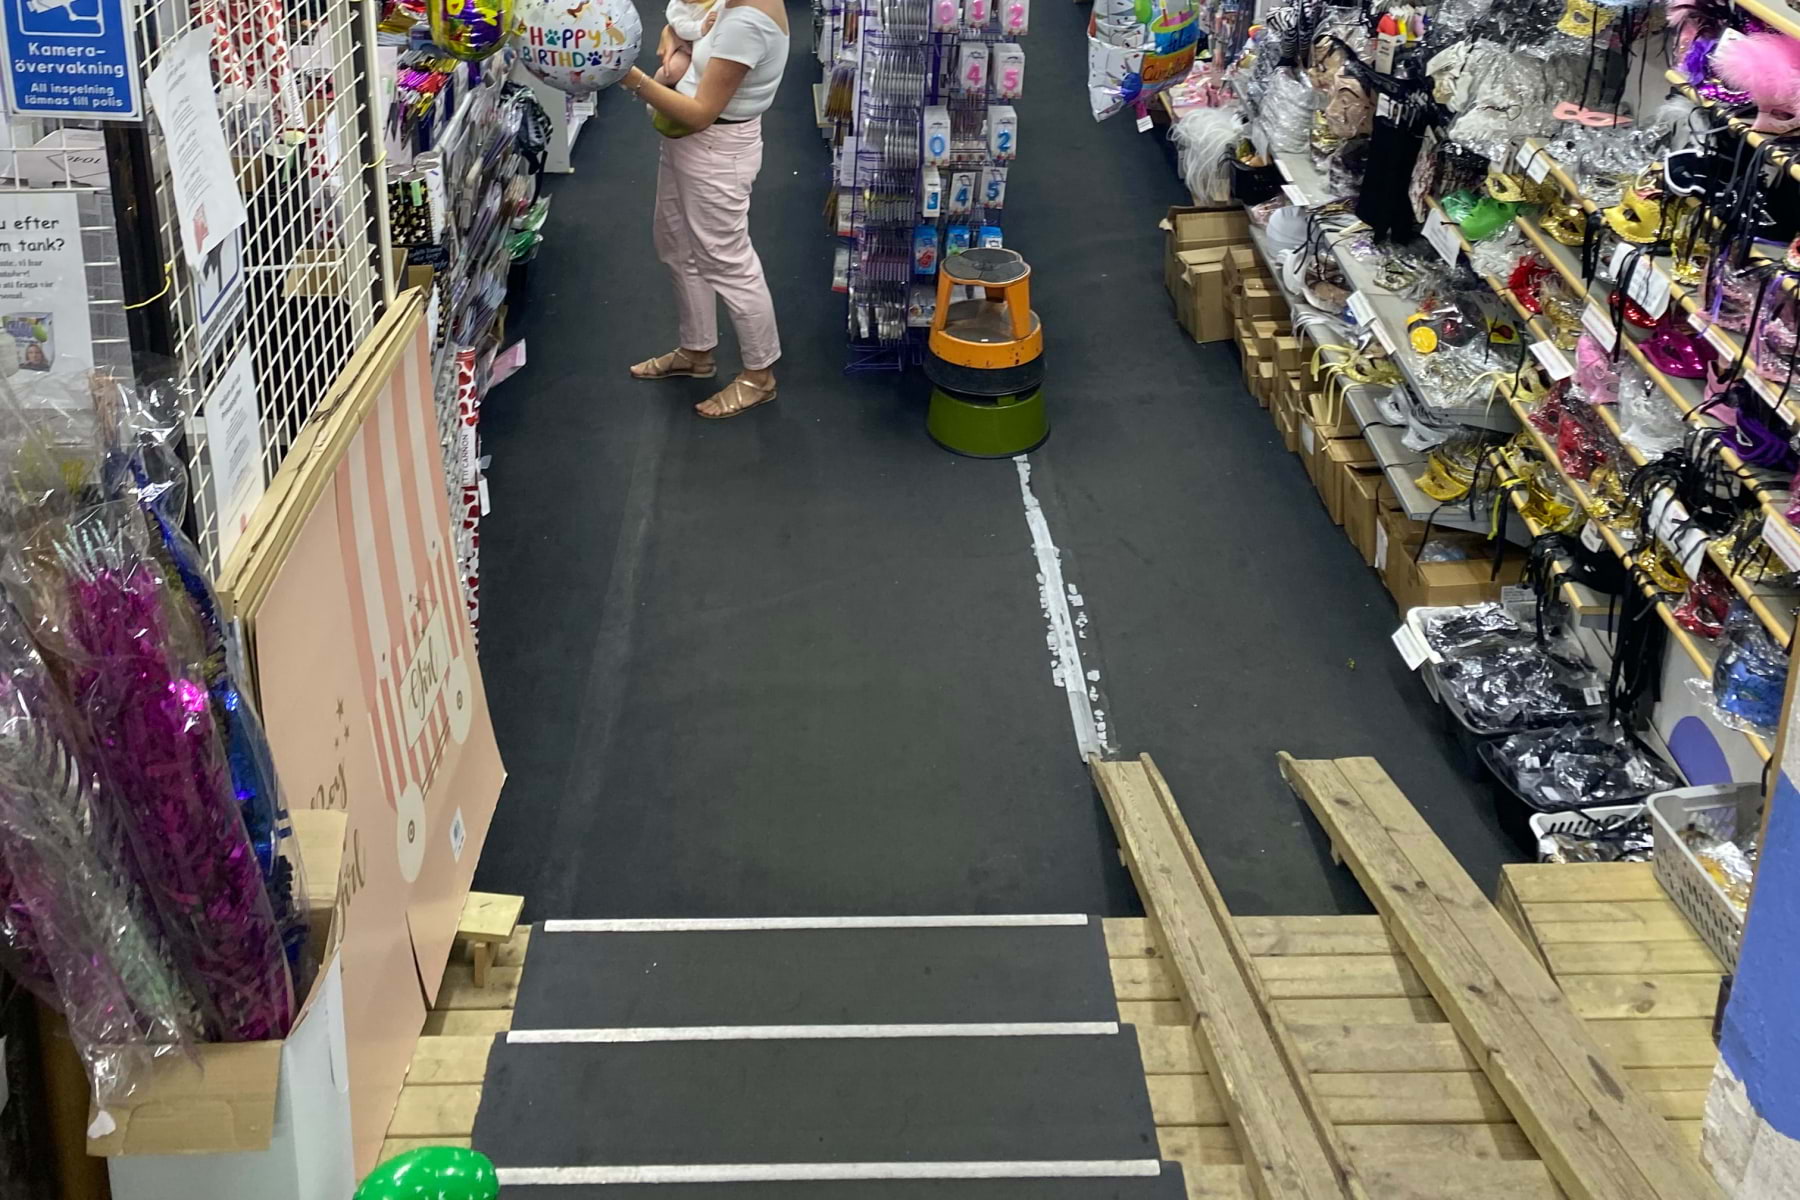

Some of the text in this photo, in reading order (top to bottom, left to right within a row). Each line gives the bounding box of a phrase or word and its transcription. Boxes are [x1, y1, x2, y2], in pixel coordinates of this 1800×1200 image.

[28, 42, 106, 57] Kamera-
[15, 59, 125, 78] övervakning
[30, 82, 114, 96] All inspelning
[24, 94, 124, 108] lämnas till polis
[14, 216, 59, 230] efter
[18, 237, 65, 251] tank?
[461, 433, 469, 468] CANNON
[408, 635, 438, 721] Girl
